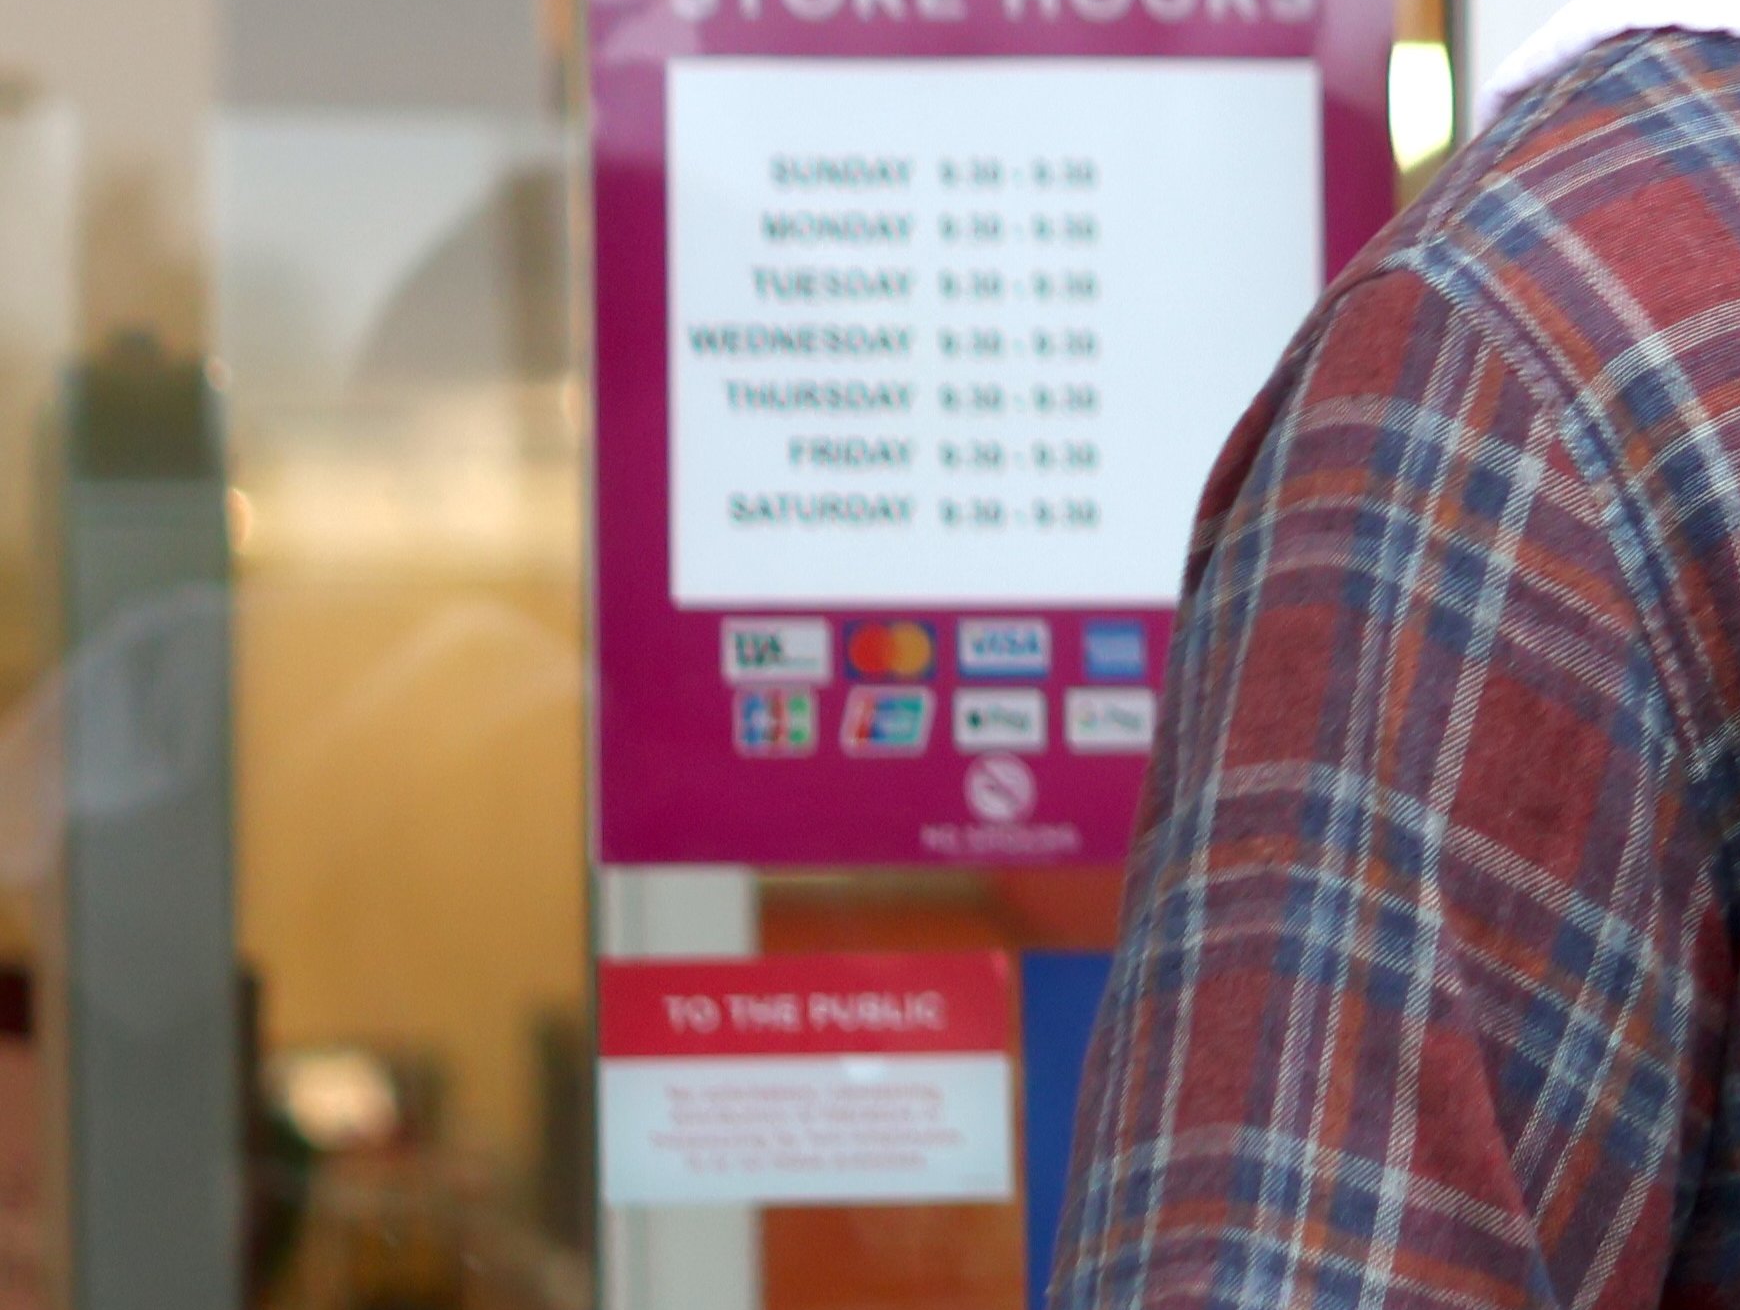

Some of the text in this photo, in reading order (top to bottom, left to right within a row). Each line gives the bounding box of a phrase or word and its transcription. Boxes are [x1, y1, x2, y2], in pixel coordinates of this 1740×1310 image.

[768, 155, 913, 189] SUNDAY
[761, 212, 913, 245] MONDAY
[751, 269, 913, 302] TUESDAY
[687, 325, 911, 357] WEDNESDAY
[725, 381, 912, 413] THURSDAY
[788, 438, 913, 470] FRIDAY
[728, 494, 913, 526] SATURDAY
[664, 989, 948, 1033] TO THE PUBLIC
